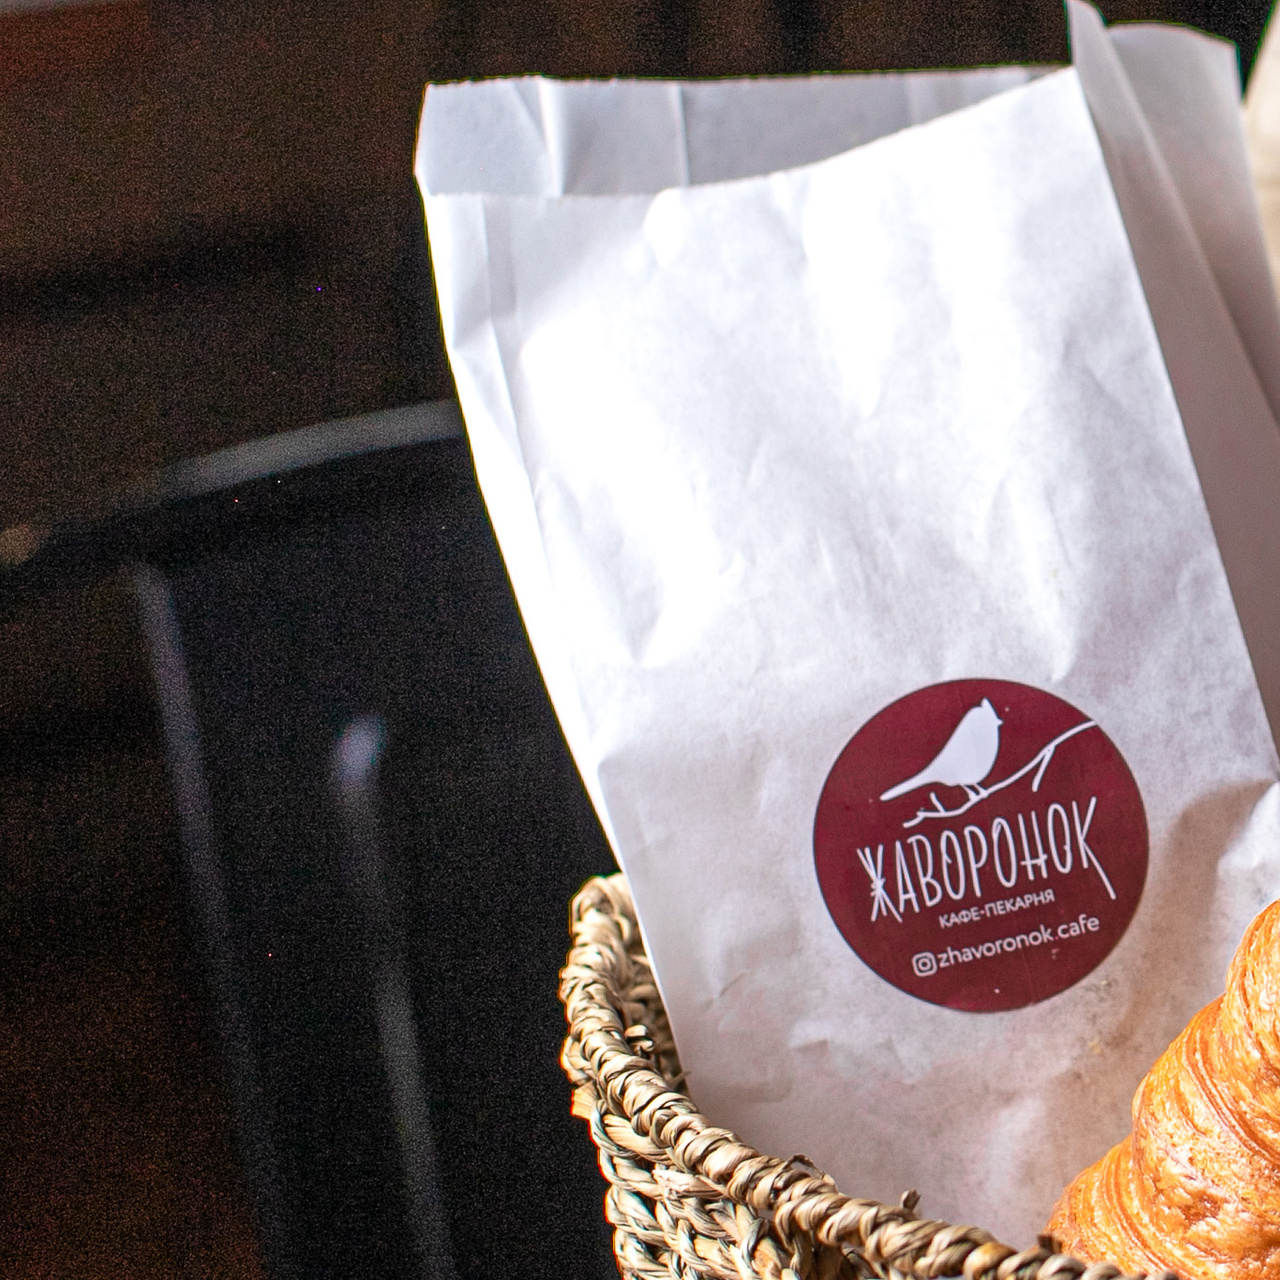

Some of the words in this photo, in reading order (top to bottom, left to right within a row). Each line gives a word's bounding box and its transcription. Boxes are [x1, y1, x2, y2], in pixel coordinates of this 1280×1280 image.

[857, 796, 1116, 922] ЖАВОРОНОК
[938, 888, 1055, 929] КАФЕ-ПЕКАРНЯ
[937, 914, 1100, 968] zhavoronok.cafe
